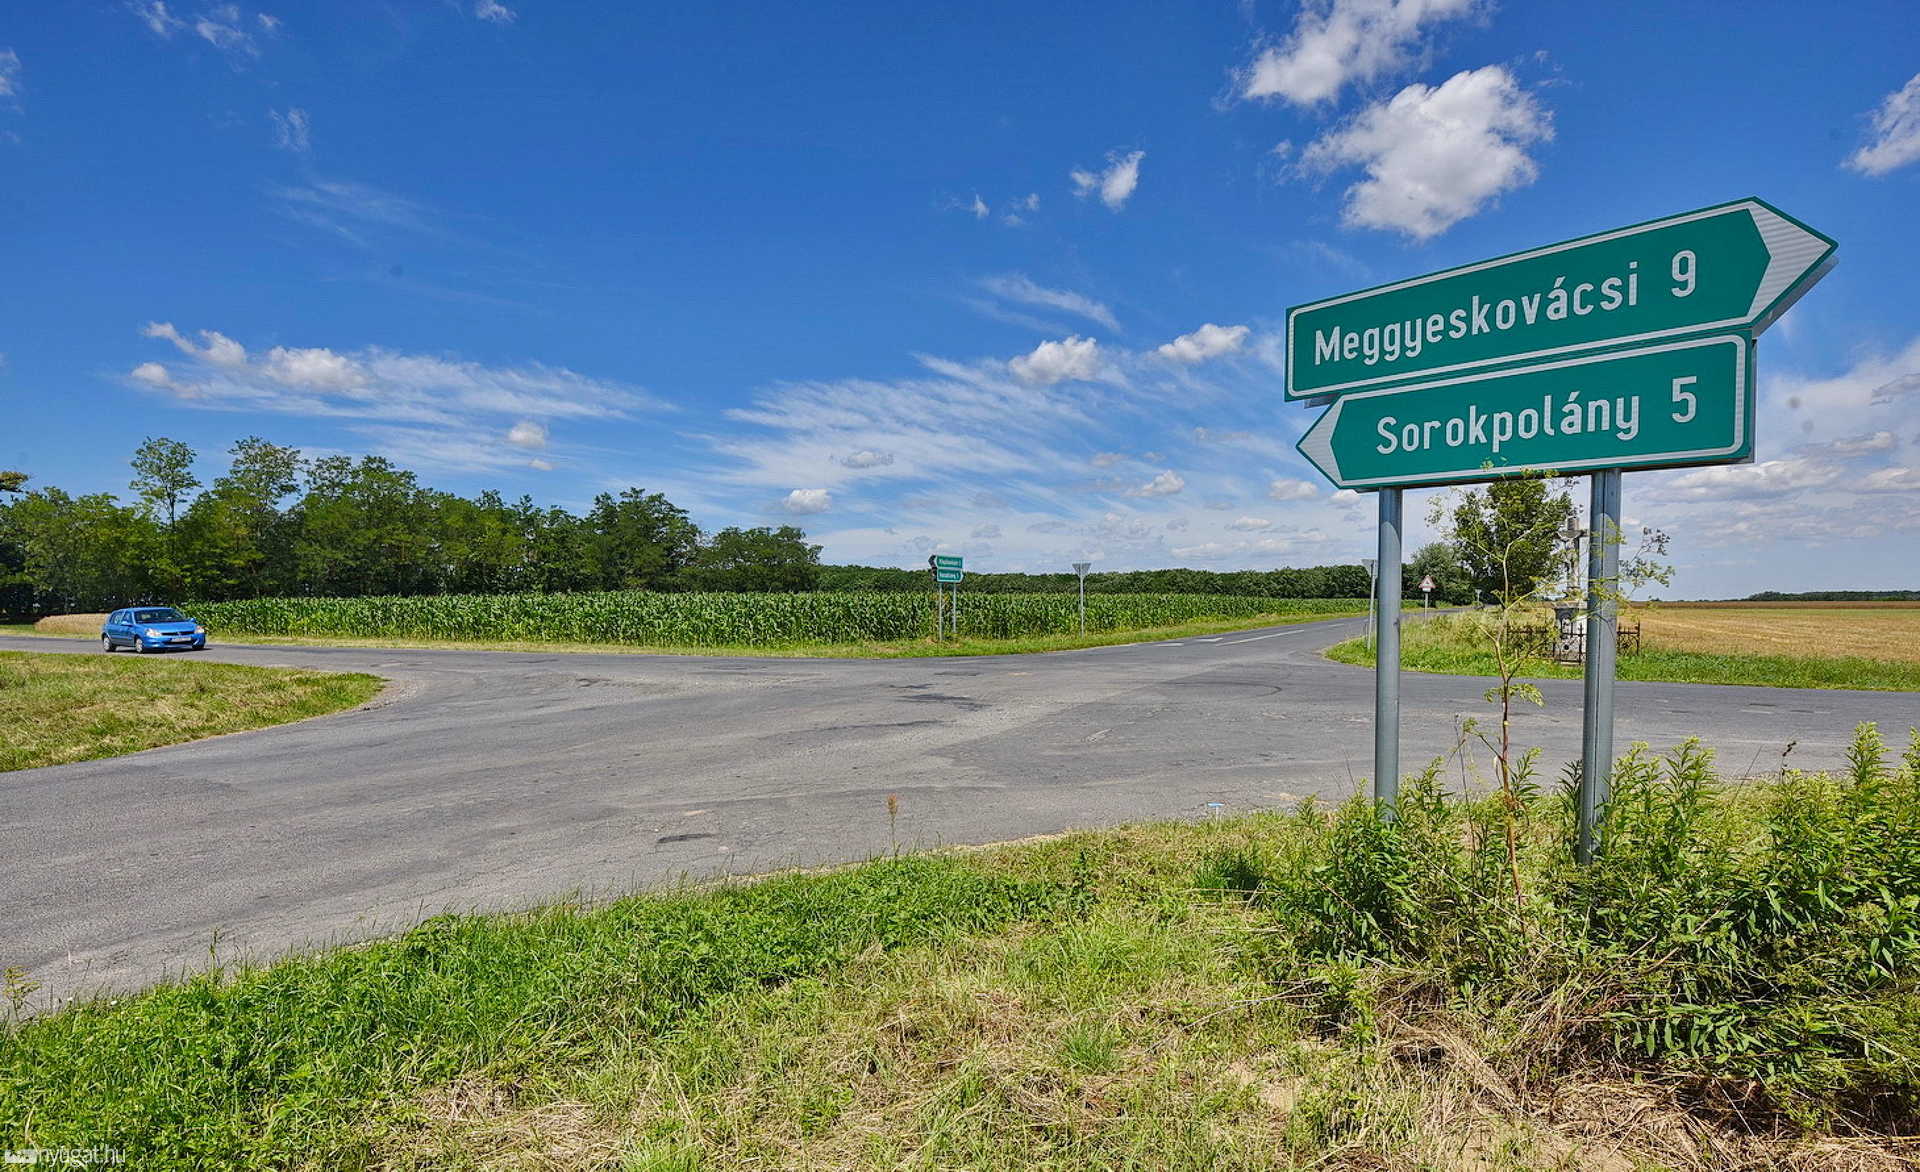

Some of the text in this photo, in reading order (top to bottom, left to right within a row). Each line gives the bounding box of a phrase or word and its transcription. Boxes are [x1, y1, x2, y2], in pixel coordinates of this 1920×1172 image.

[1314, 250, 1696, 367] Meggyeskovácsi 9
[1376, 375, 1697, 454] Sorokpolány 5
